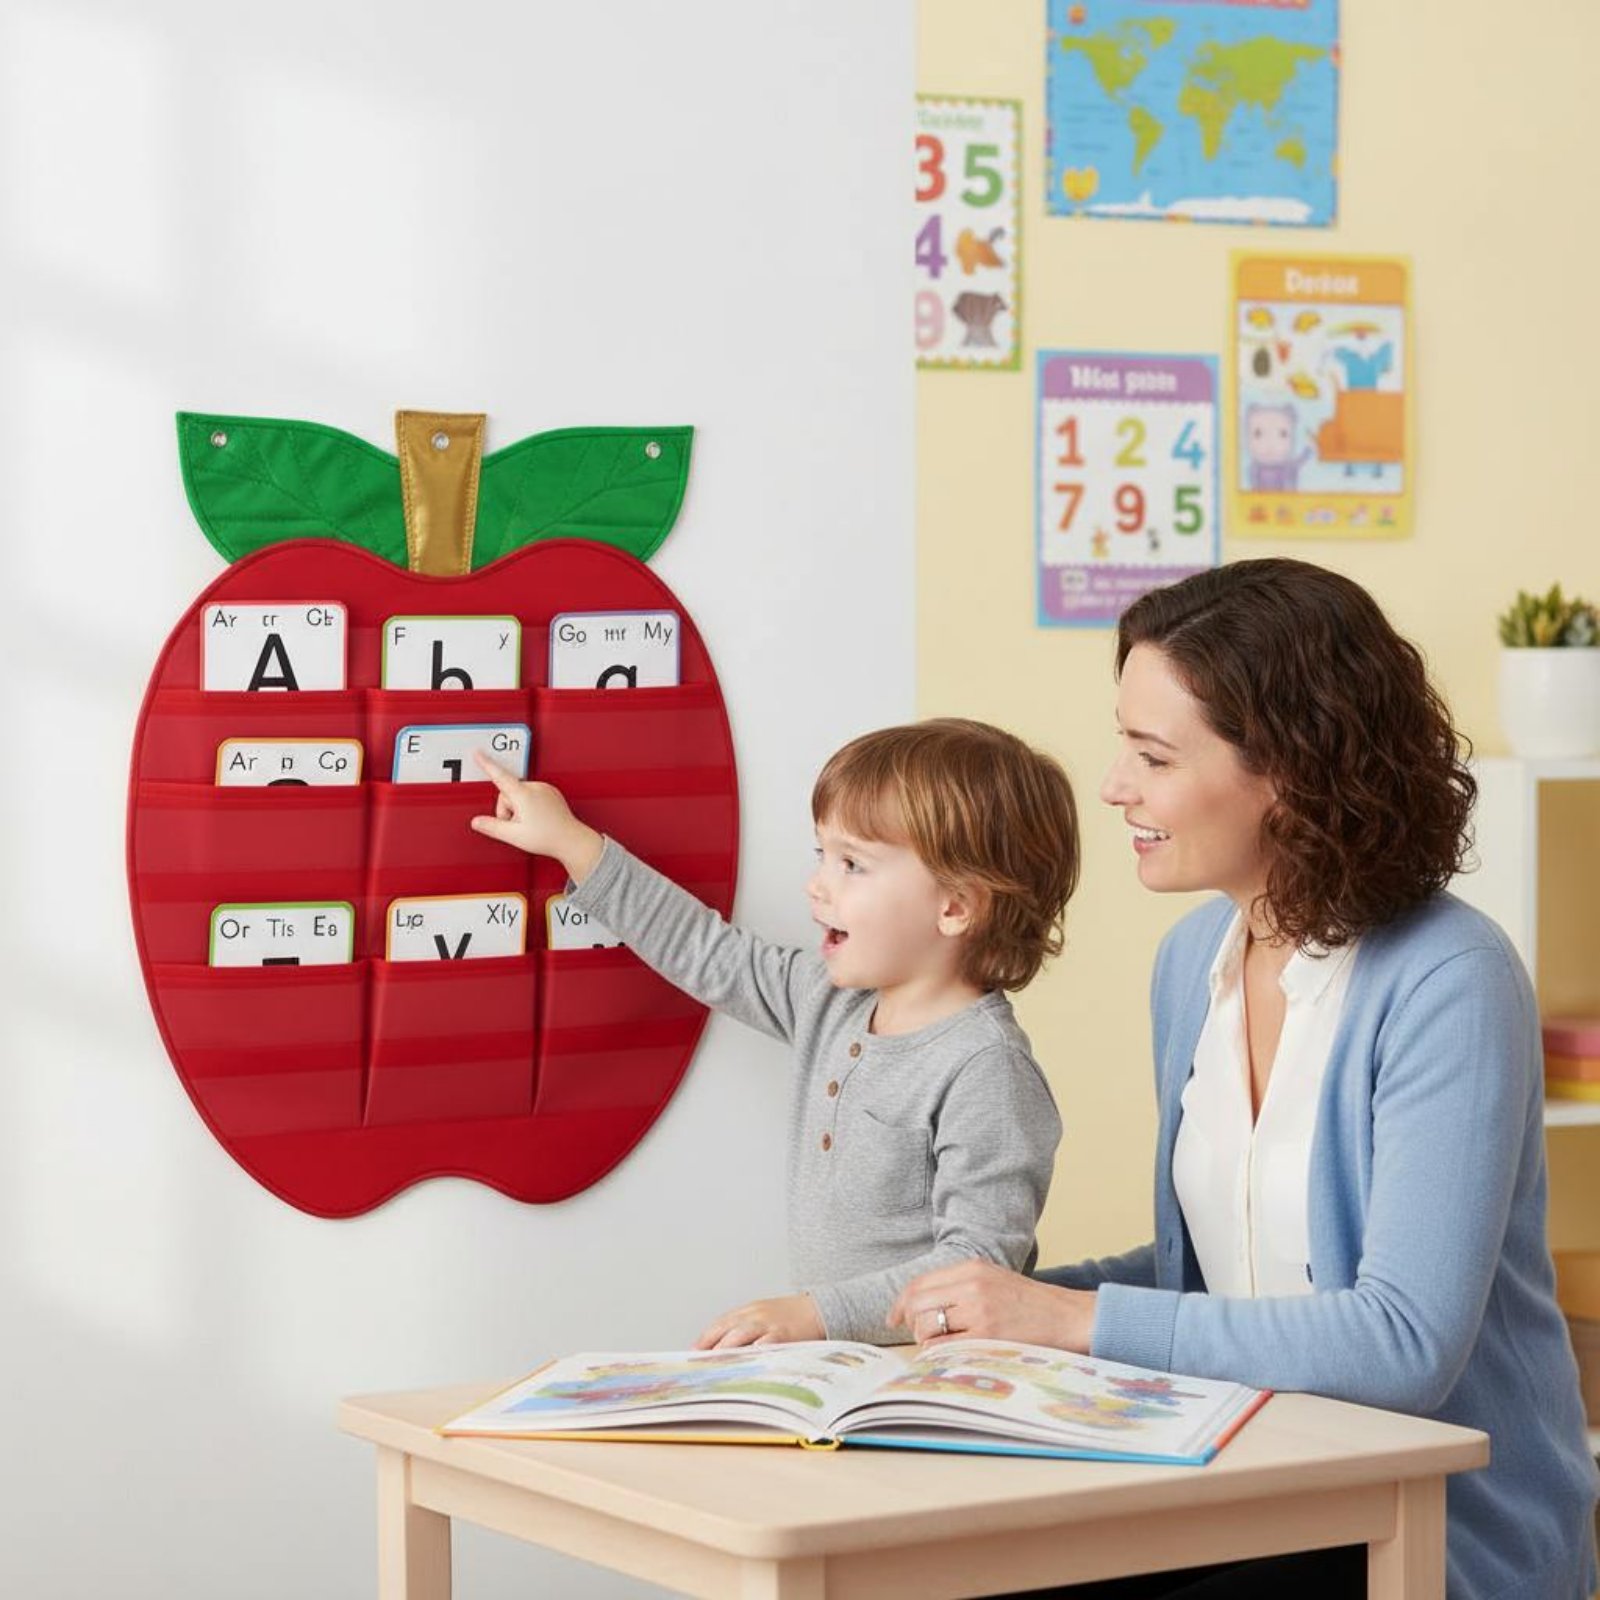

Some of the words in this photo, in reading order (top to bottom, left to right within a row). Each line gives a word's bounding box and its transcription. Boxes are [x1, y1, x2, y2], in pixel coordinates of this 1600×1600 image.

[915, 134, 947, 203] 3
[960, 144, 1004, 209] 5
[915, 213, 949, 280] 4
[1055, 415, 1086, 468] 1
[1113, 415, 1148, 468] 2
[1171, 419, 1207, 471] 4
[1053, 483, 1086, 532] 7
[1113, 482, 1147, 535] 9
[1173, 485, 1205, 535] 5
[212, 609, 238, 628] Ar
[394, 626, 406, 646] F
[559, 623, 587, 643] Go
[644, 621, 673, 646] My
[247, 633, 300, 692] A
[407, 735, 421, 753] E
[491, 733, 520, 751] Gn
[229, 751, 259, 771] Ar
[220, 918, 251, 939] Or
